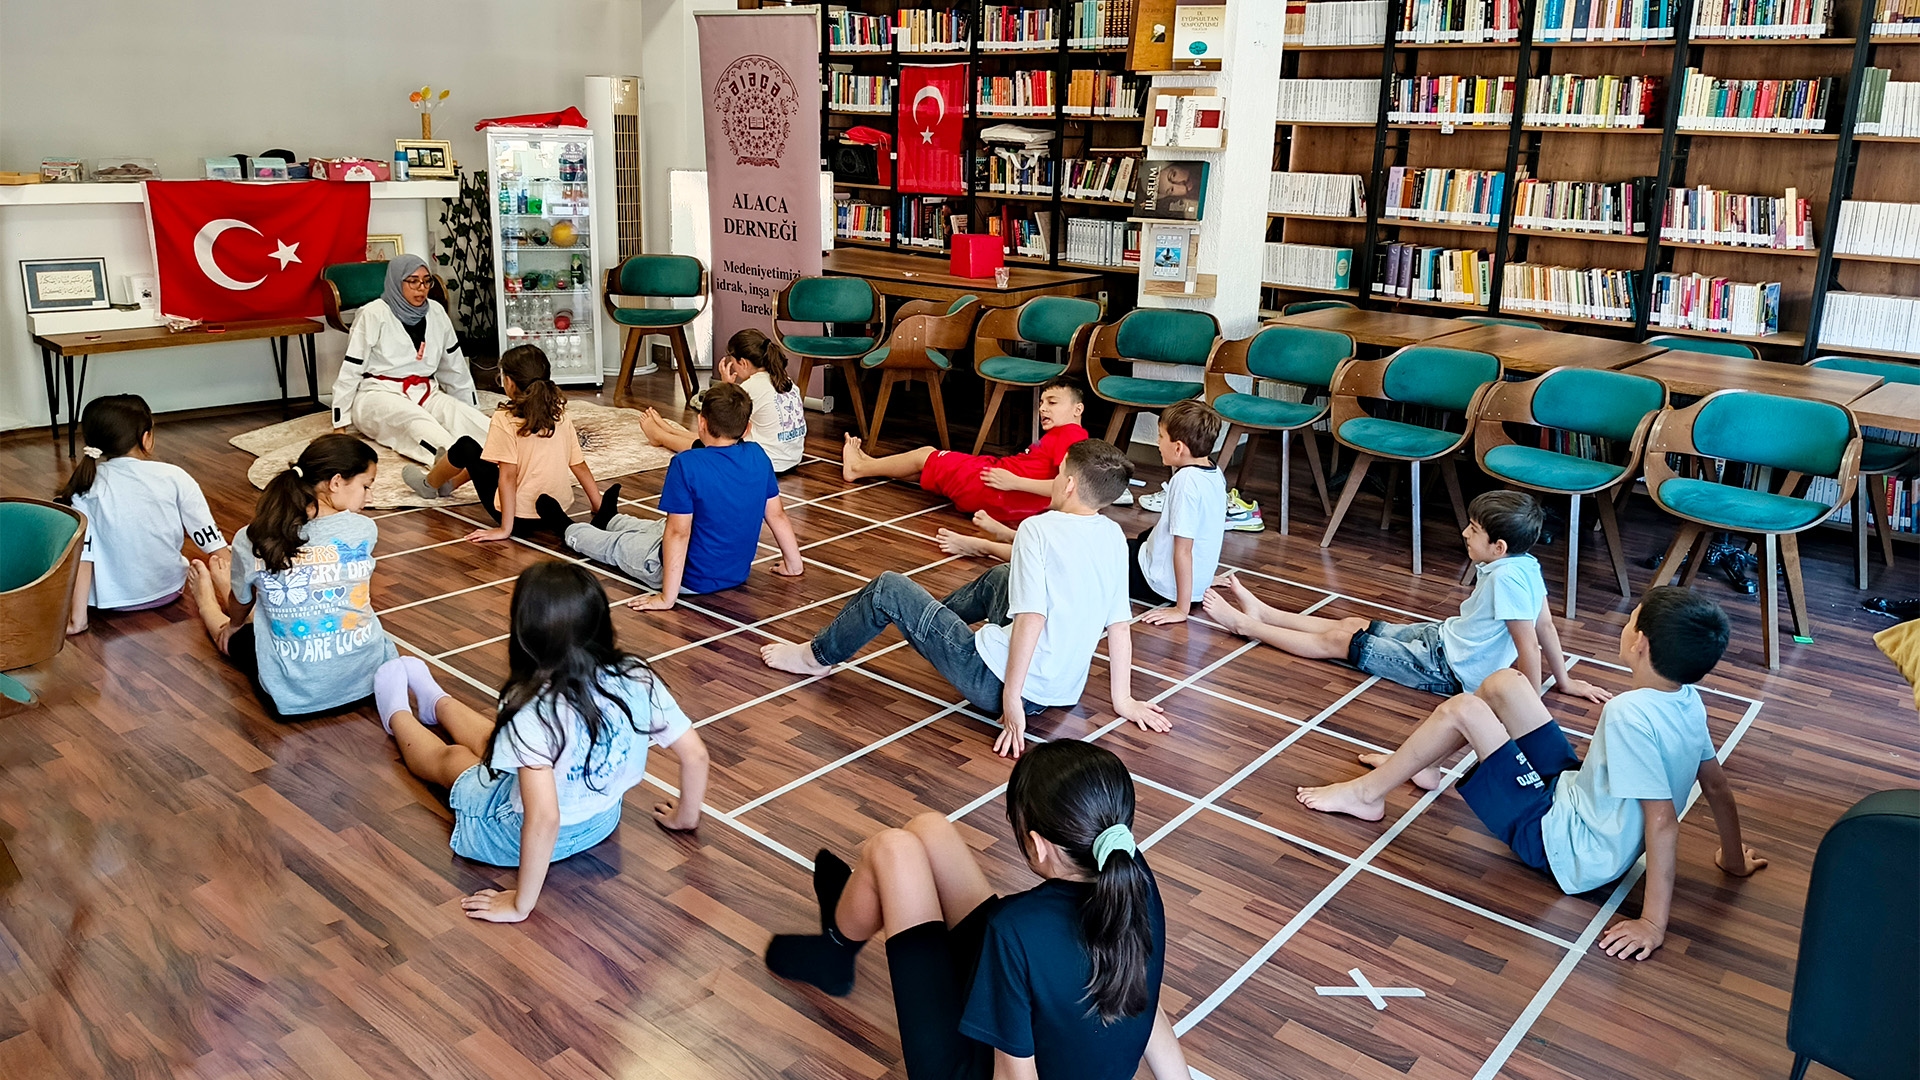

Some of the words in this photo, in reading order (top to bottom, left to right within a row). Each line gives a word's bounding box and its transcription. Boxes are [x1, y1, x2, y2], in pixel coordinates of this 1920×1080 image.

[732, 192, 789, 214] ALACA
[723, 217, 798, 242] DERNEĞİ
[716, 278, 748, 296] idrak,
[749, 283, 770, 299] inşa
[272, 638, 299, 660] YOU
[302, 636, 332, 662] ARE
[336, 622, 372, 655] LUCKY
